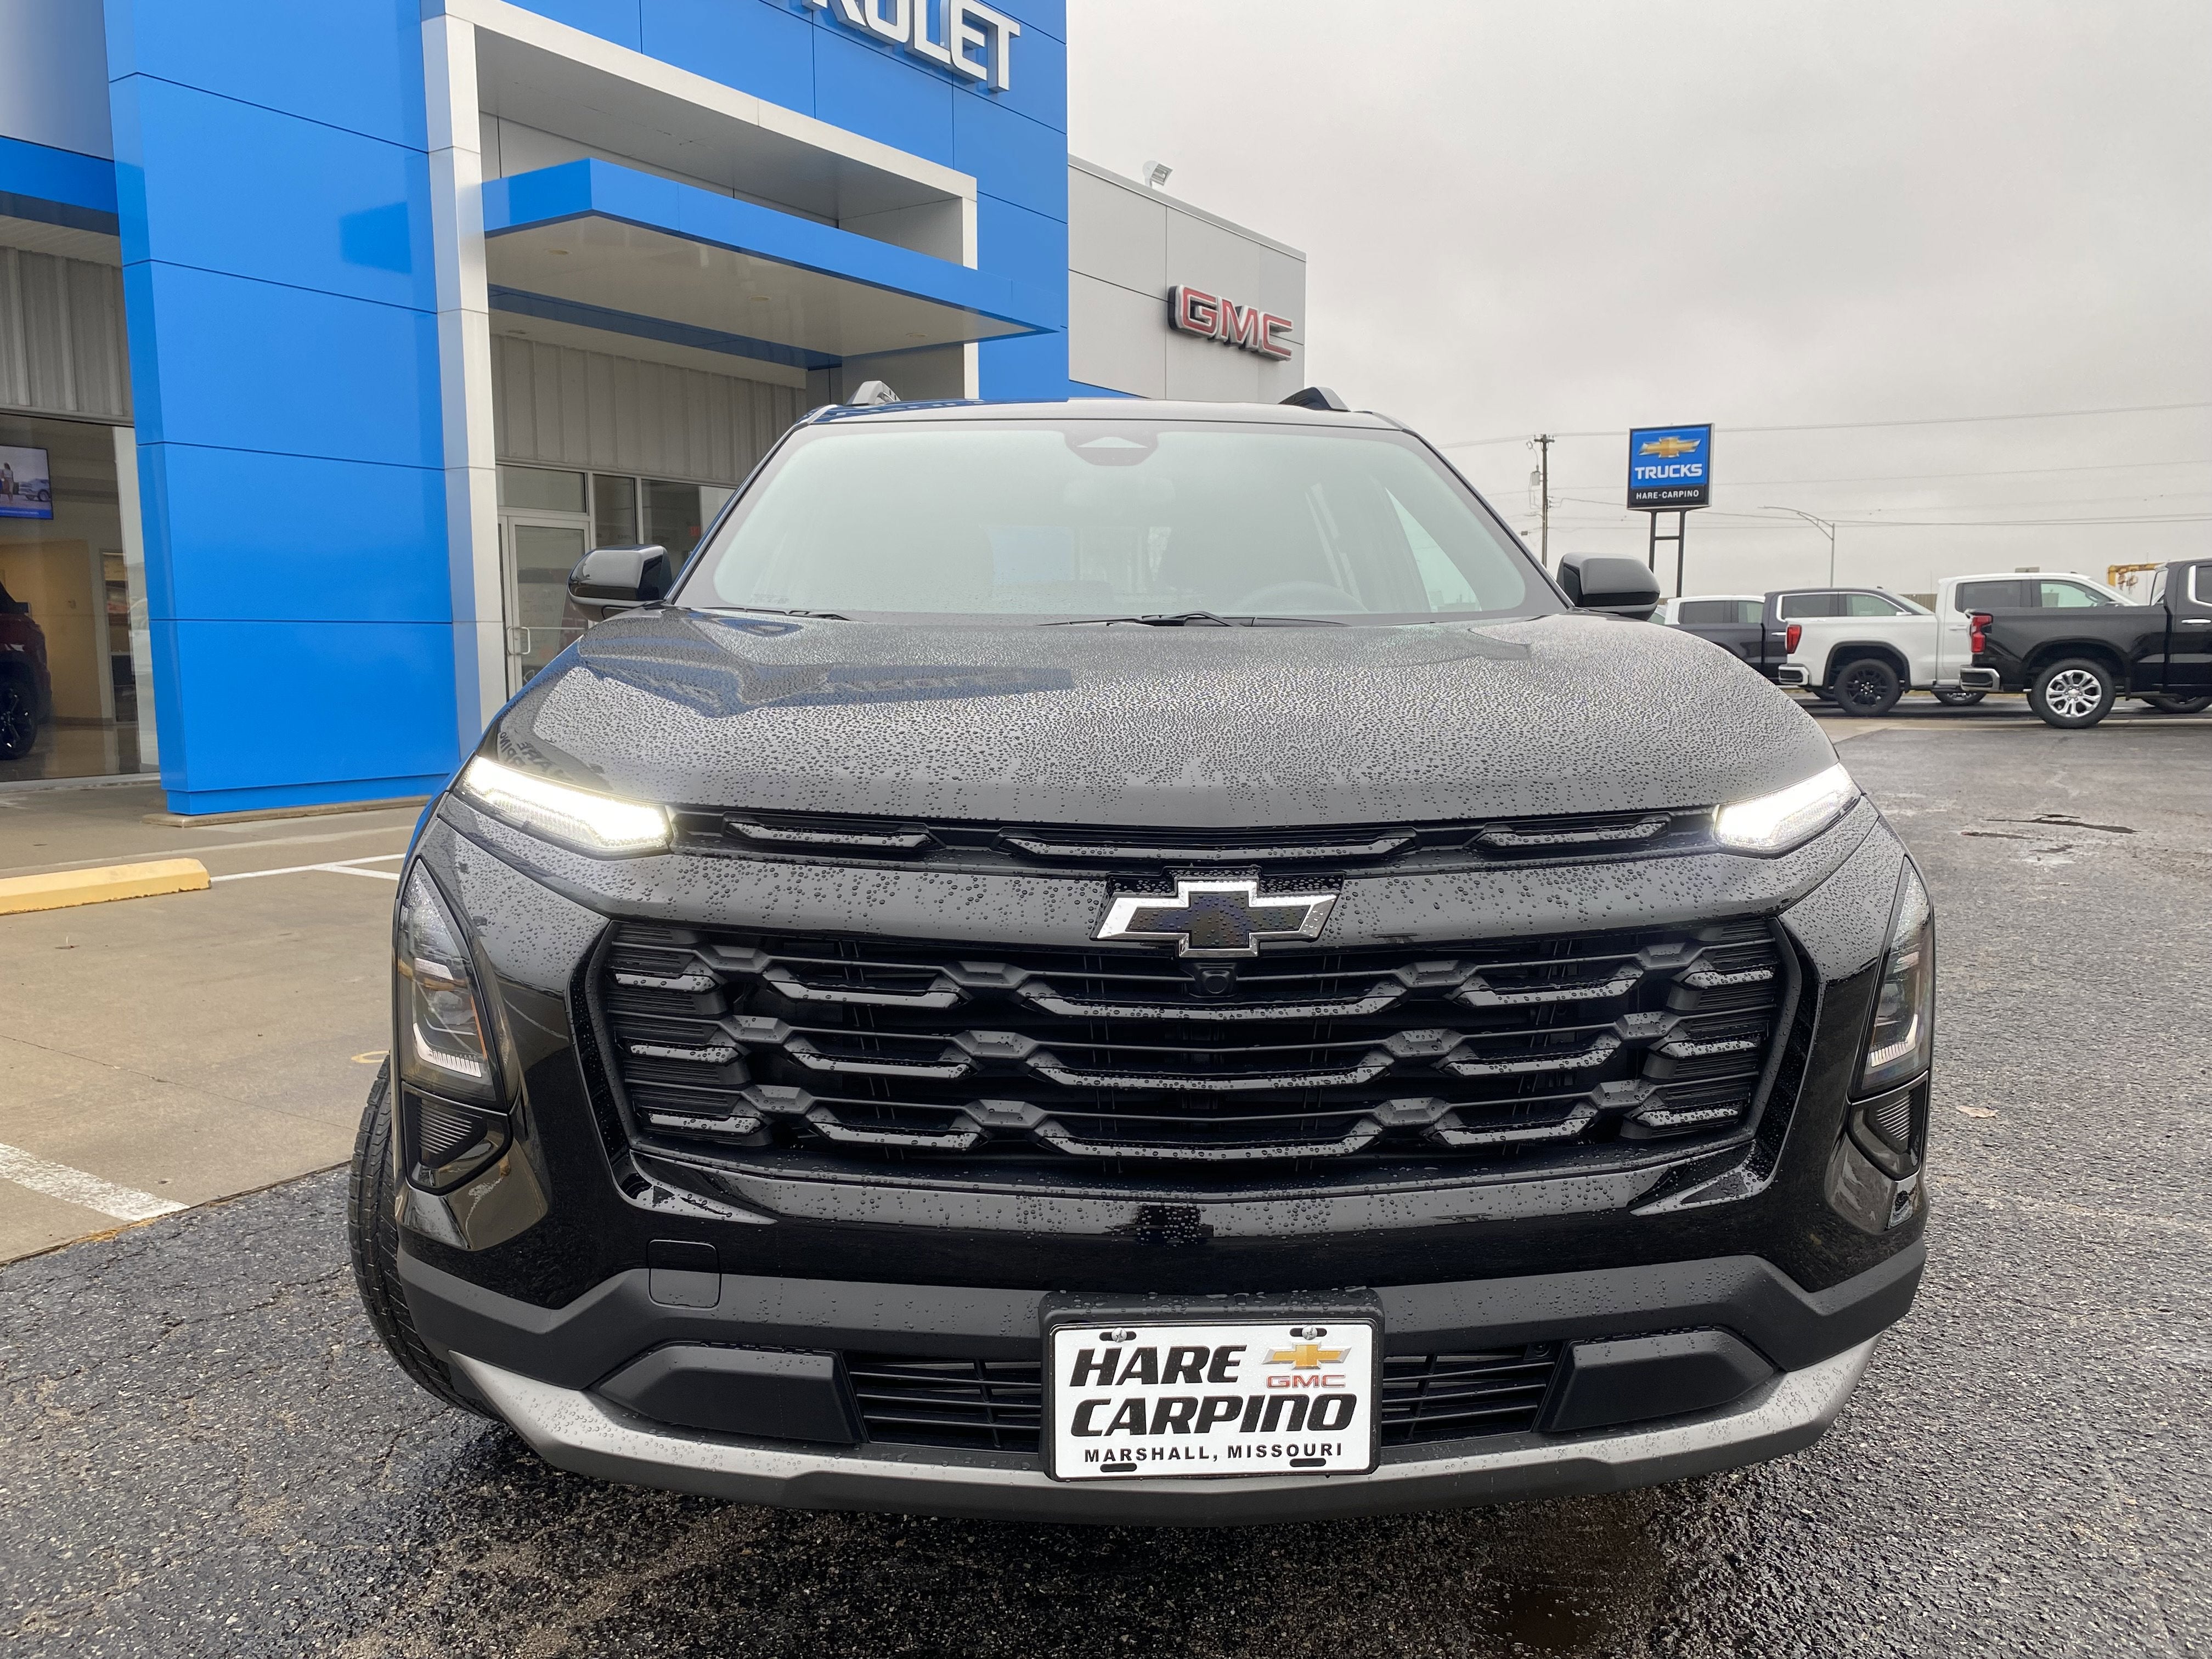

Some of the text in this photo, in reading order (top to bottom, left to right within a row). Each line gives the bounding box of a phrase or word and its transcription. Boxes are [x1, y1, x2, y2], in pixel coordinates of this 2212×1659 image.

[803, 0, 1020, 92] LET
[1169, 284, 1293, 361] GMC
[1635, 463, 1702, 479] TRUCKS
[1636, 489, 1699, 500] HARE-CARPINO
[1069, 1344, 1248, 1387] HARE
[1266, 1373, 1346, 1389] GMC
[1070, 1393, 1357, 1437] CARPINO
[1084, 1443, 1342, 1463] MARSHALL, MISSOURI
